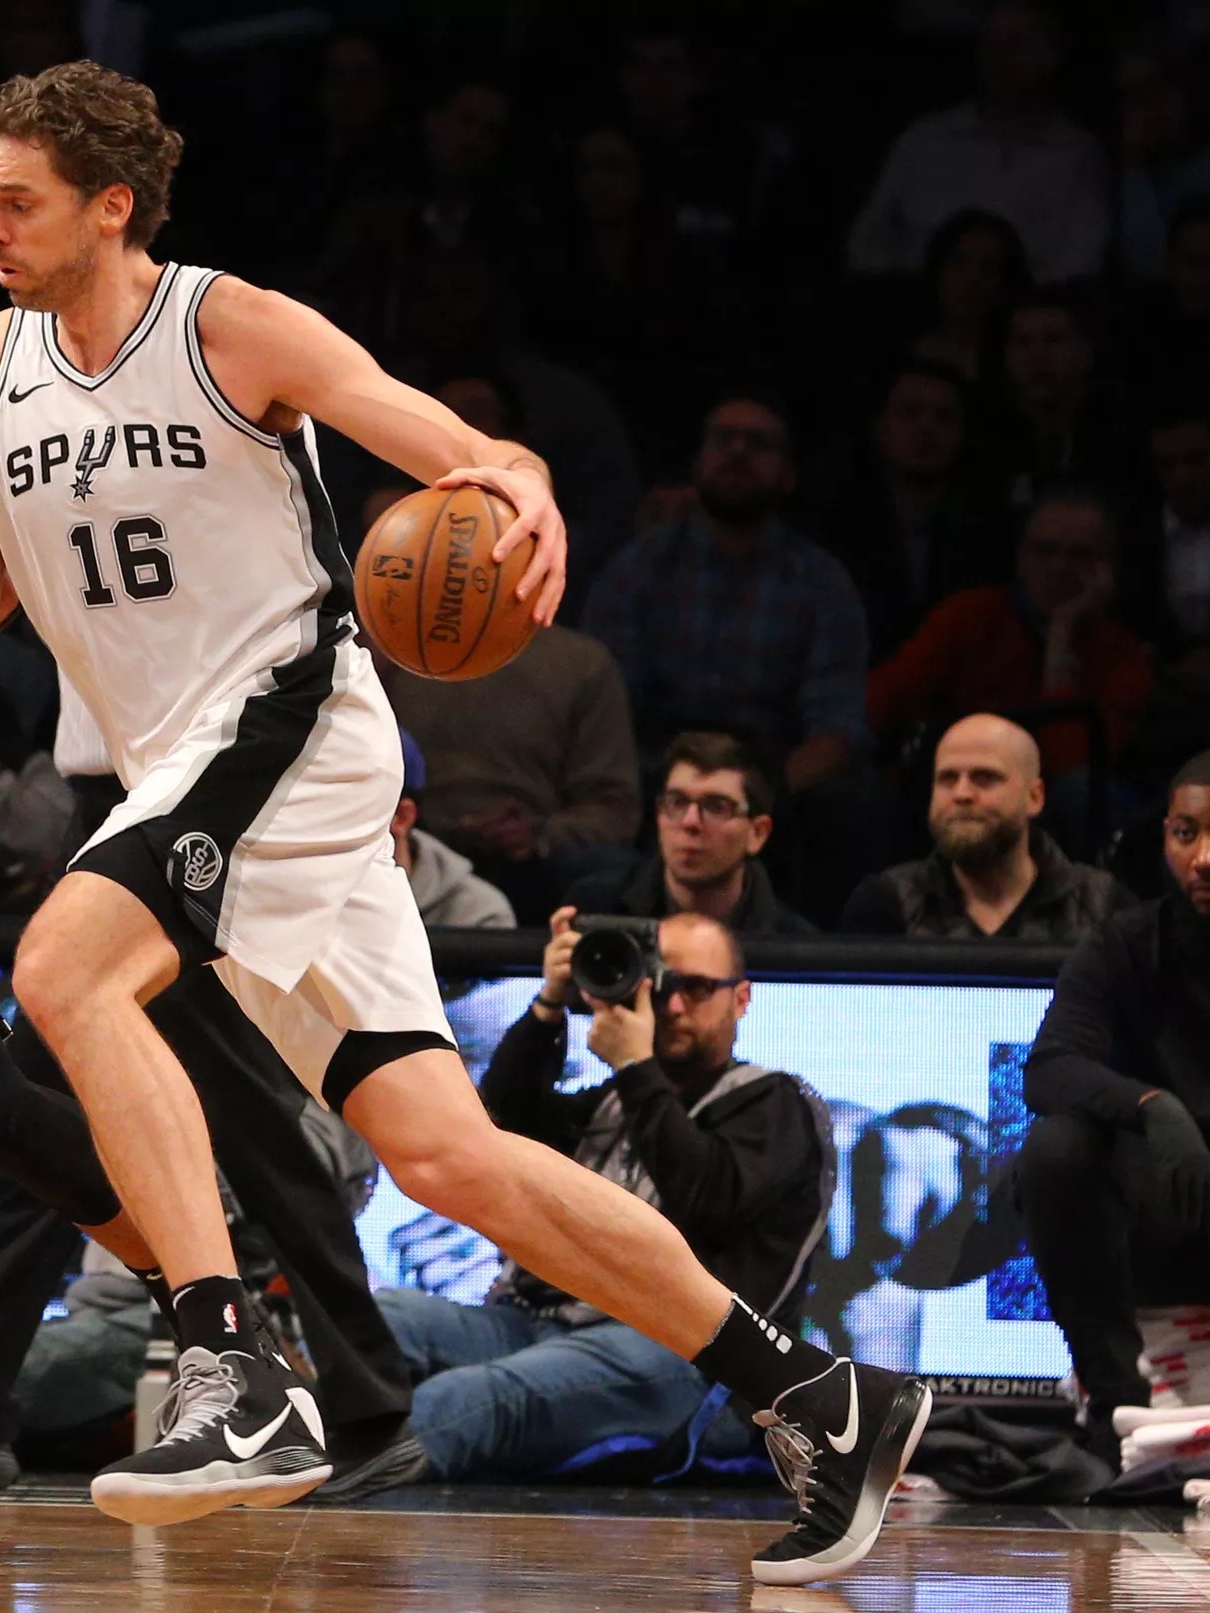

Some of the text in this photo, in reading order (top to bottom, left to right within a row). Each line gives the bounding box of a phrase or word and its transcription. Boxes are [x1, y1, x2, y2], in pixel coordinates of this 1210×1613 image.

[6, 424, 207, 502] SPURS
[67, 513, 177, 609] 16
[428, 512, 478, 644] SPALDING
[924, 1376, 1064, 1397] AKTRONIC
